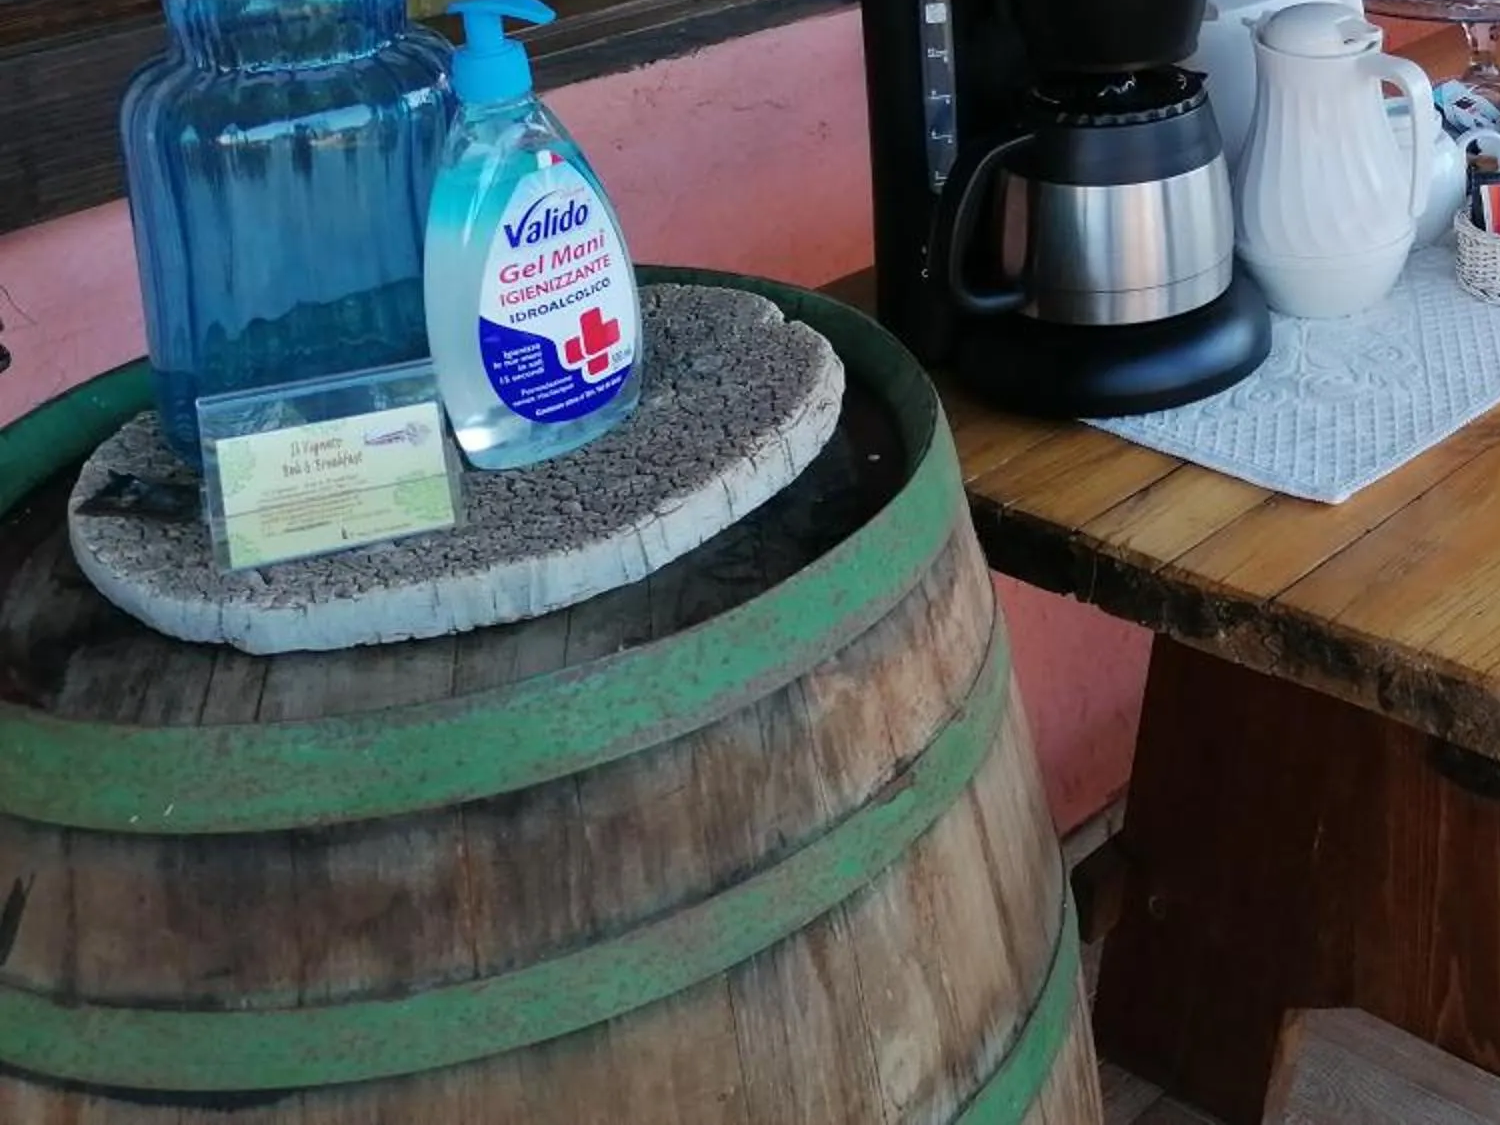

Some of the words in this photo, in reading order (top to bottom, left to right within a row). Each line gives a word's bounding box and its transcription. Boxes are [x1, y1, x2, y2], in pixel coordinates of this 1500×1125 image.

[503, 191, 588, 249] Valido
[499, 254, 545, 284] Gel
[551, 228, 605, 270] Mani
[499, 254, 611, 307] IGIENIZZANTE
[509, 276, 611, 324] IDROALCOLICO
